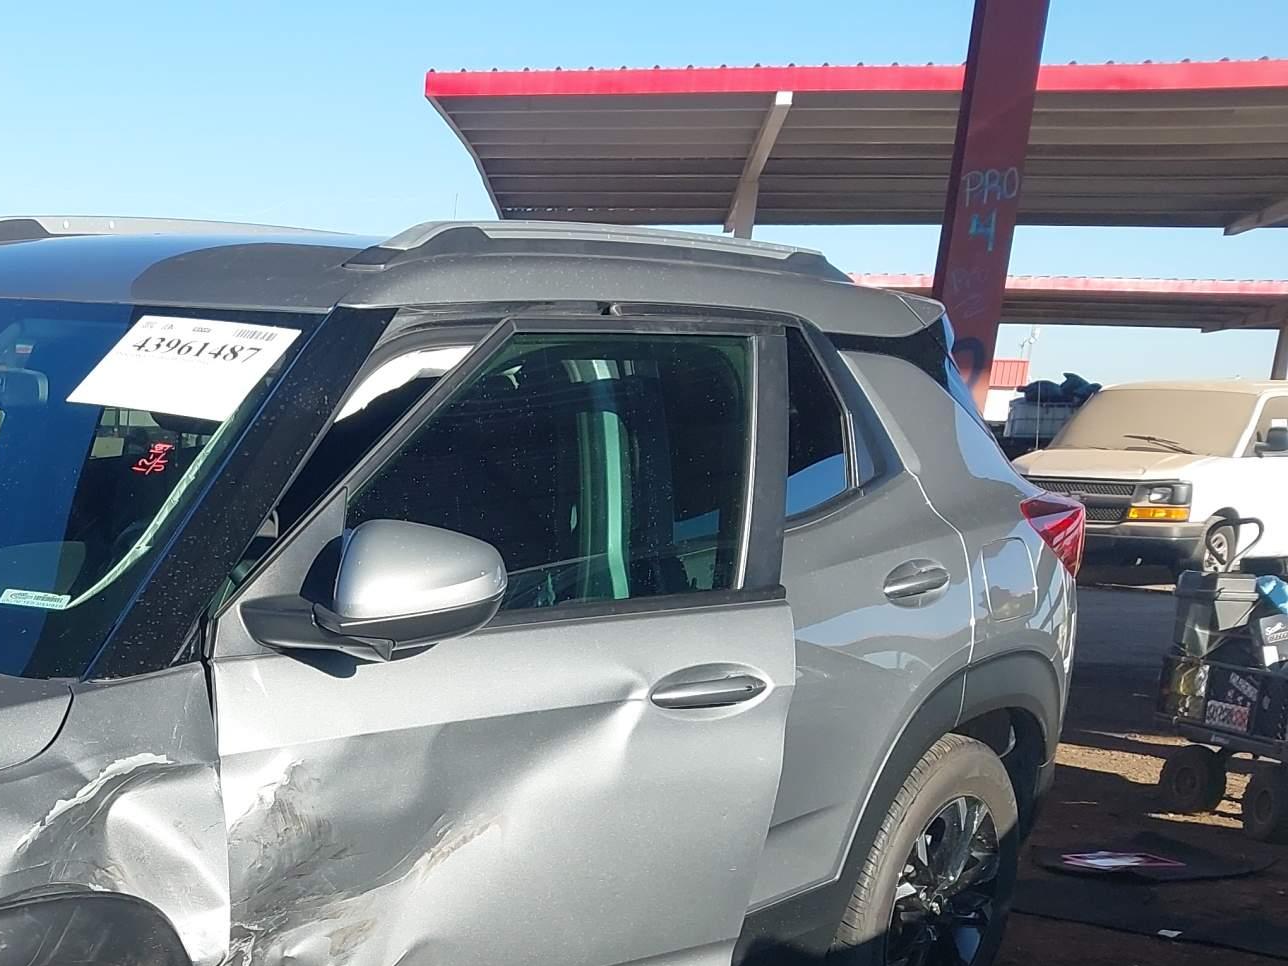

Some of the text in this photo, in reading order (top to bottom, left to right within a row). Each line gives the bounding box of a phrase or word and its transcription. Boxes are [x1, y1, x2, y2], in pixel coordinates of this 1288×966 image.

[961, 166, 1020, 207] PRO
[968, 208, 998, 251] 4
[132, 336, 262, 364] 43961487
